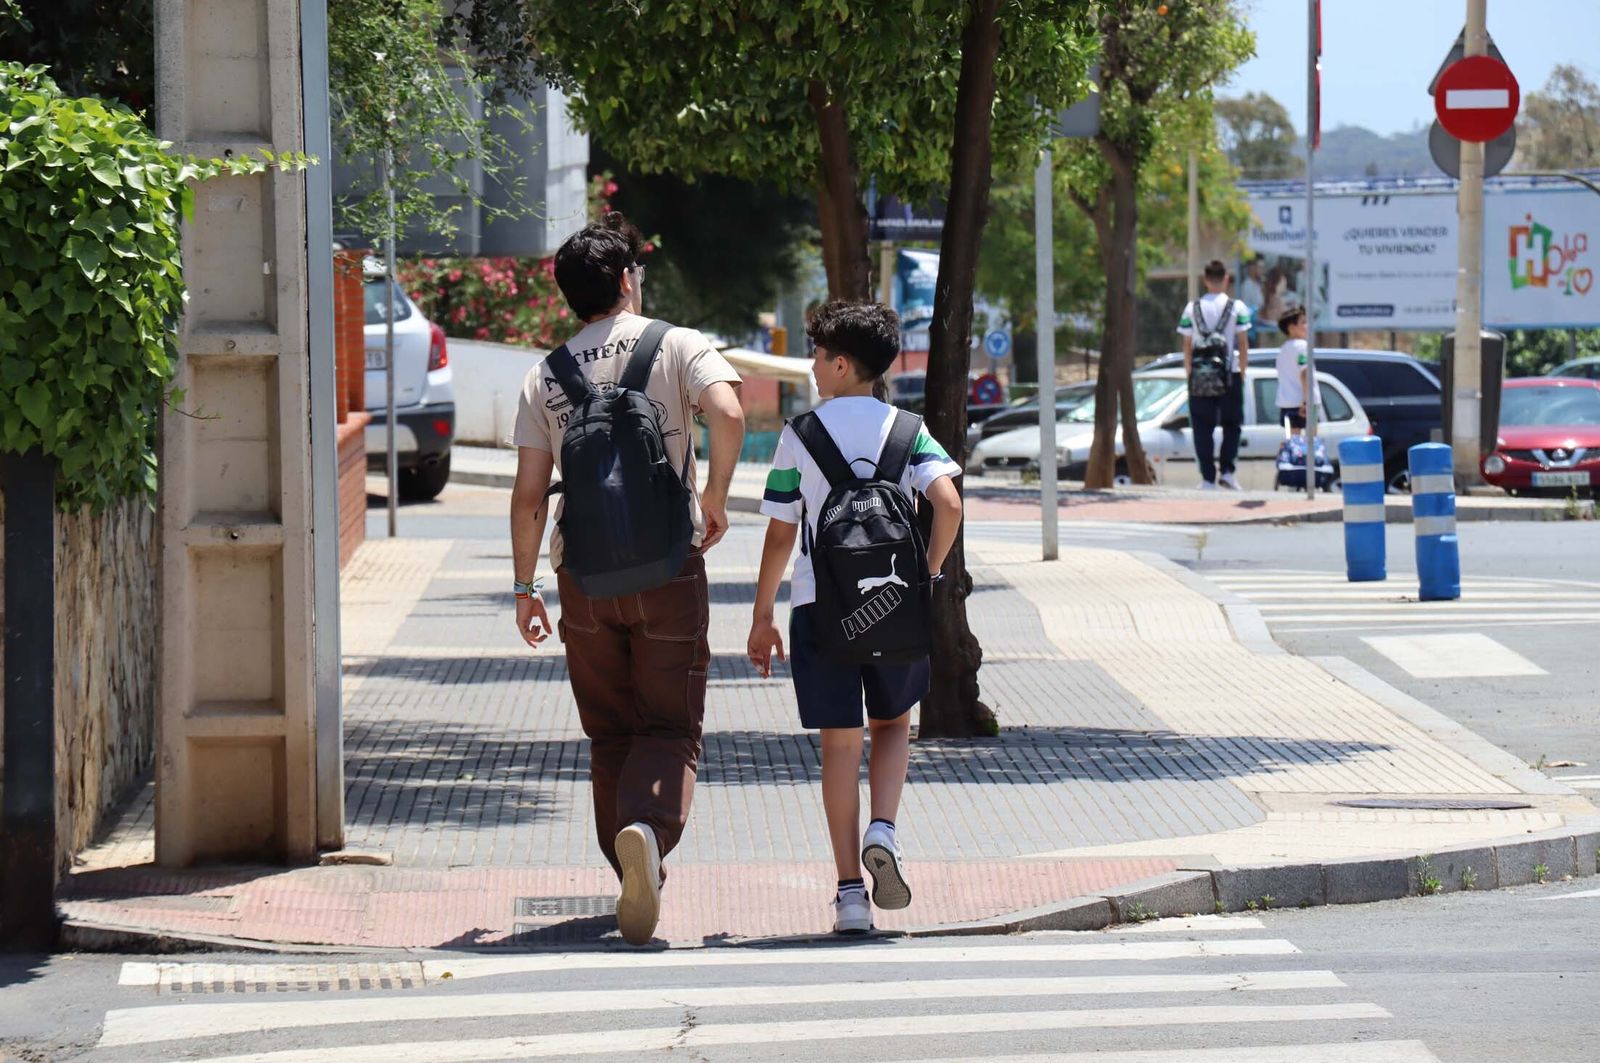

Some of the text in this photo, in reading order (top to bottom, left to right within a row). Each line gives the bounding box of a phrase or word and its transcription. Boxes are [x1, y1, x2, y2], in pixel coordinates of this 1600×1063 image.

[1400, 226, 1448, 238] VENDER
[1359, 244, 1373, 255] TU
[852, 497, 882, 512] PUMA
[841, 584, 902, 640] PUMA
